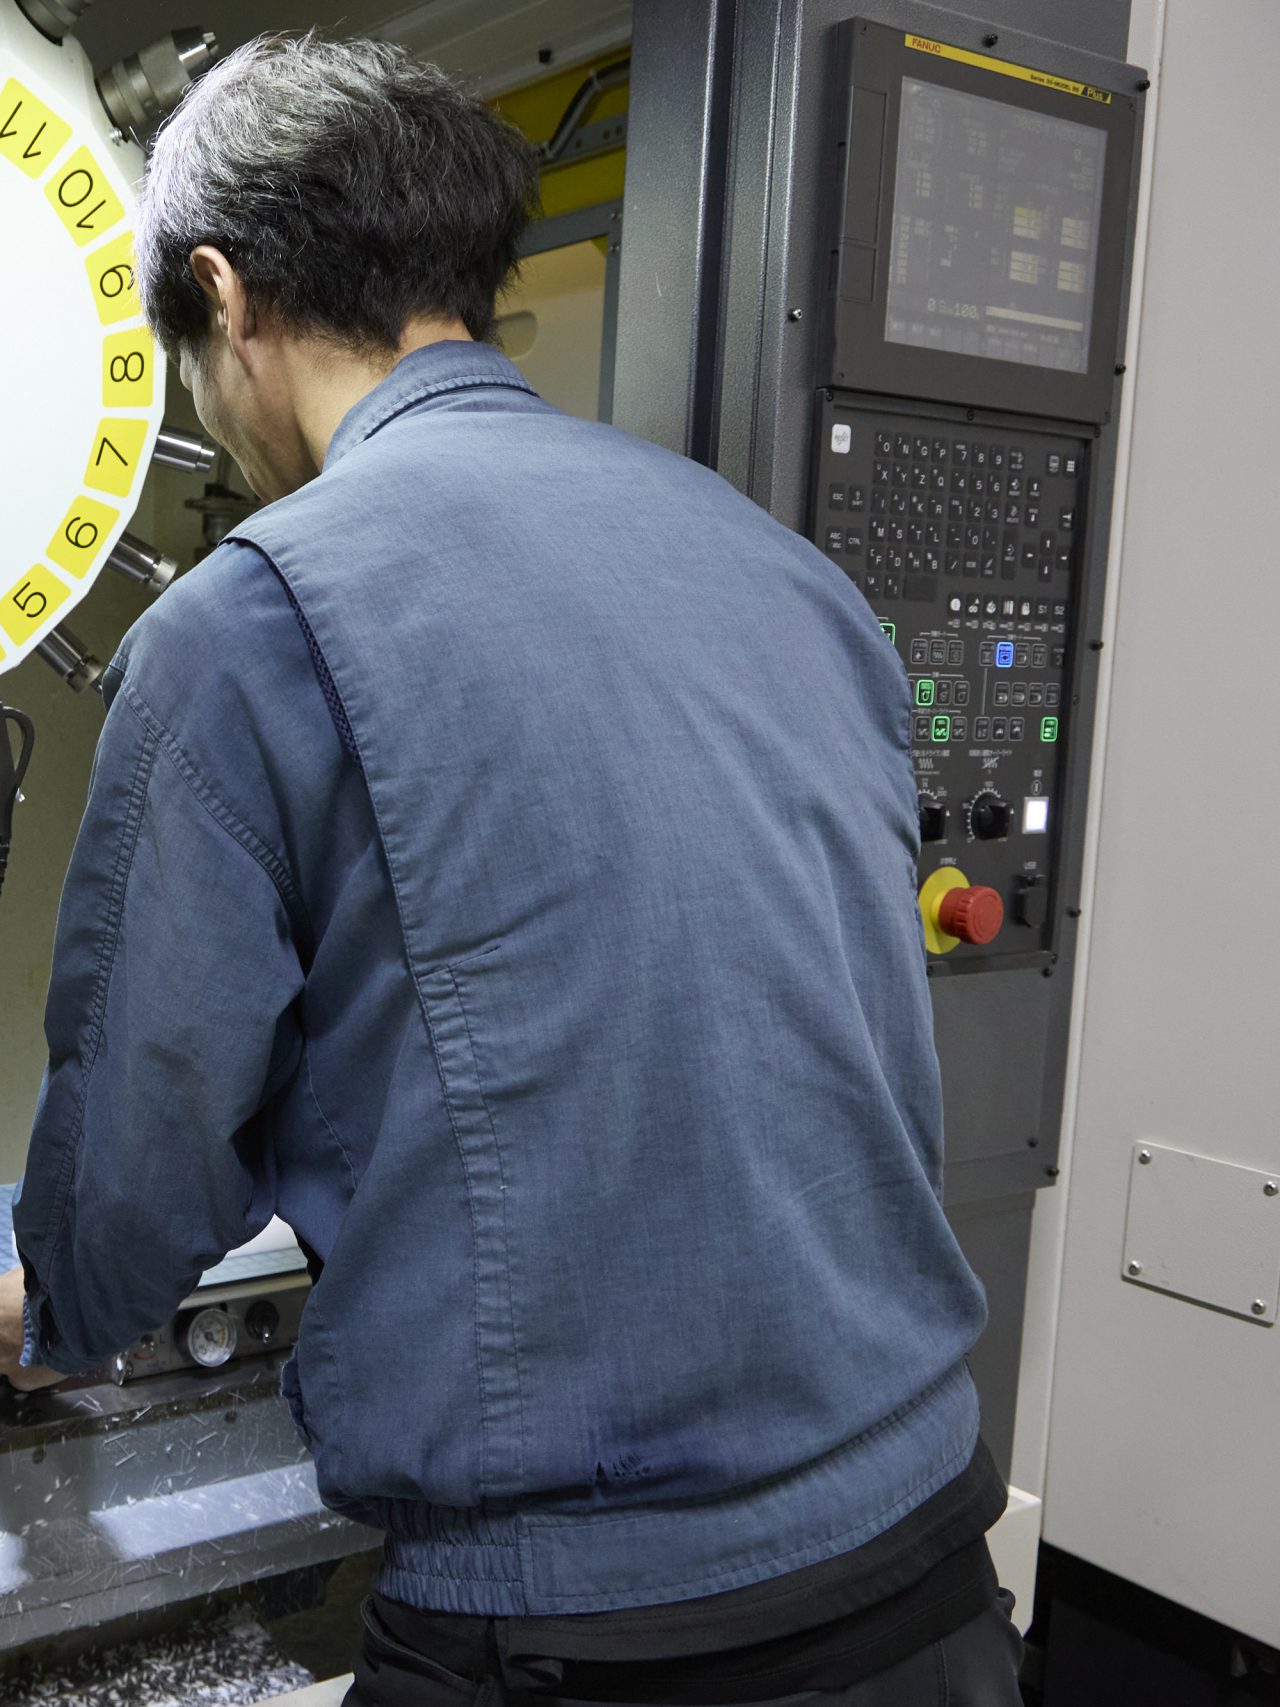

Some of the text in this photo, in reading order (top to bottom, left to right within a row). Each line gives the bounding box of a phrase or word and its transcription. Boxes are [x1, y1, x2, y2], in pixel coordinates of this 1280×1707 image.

[912, 38, 941, 53] FANUC
[58, 169, 106, 230] 10
[110, 351, 145, 382] 8
[96, 436, 128, 468] 7
[962, 451, 967, 460] 7
[978, 453, 985, 462] 8
[996, 455, 1002, 464] 9
[901, 473, 907, 482] Y
[919, 475, 925, 484] Z
[938, 477, 944, 487] Q
[958, 479, 964, 487] 4
[976, 481, 982, 490] 5
[994, 483, 1000, 492] 6
[974, 507, 980, 517] 2
[992, 509, 998, 518] 3
[896, 530, 903, 539] S
[916, 530, 922, 540] T
[934, 533, 939, 542] L
[876, 556, 937, 570] F H B
[13, 581, 47, 618] 5
